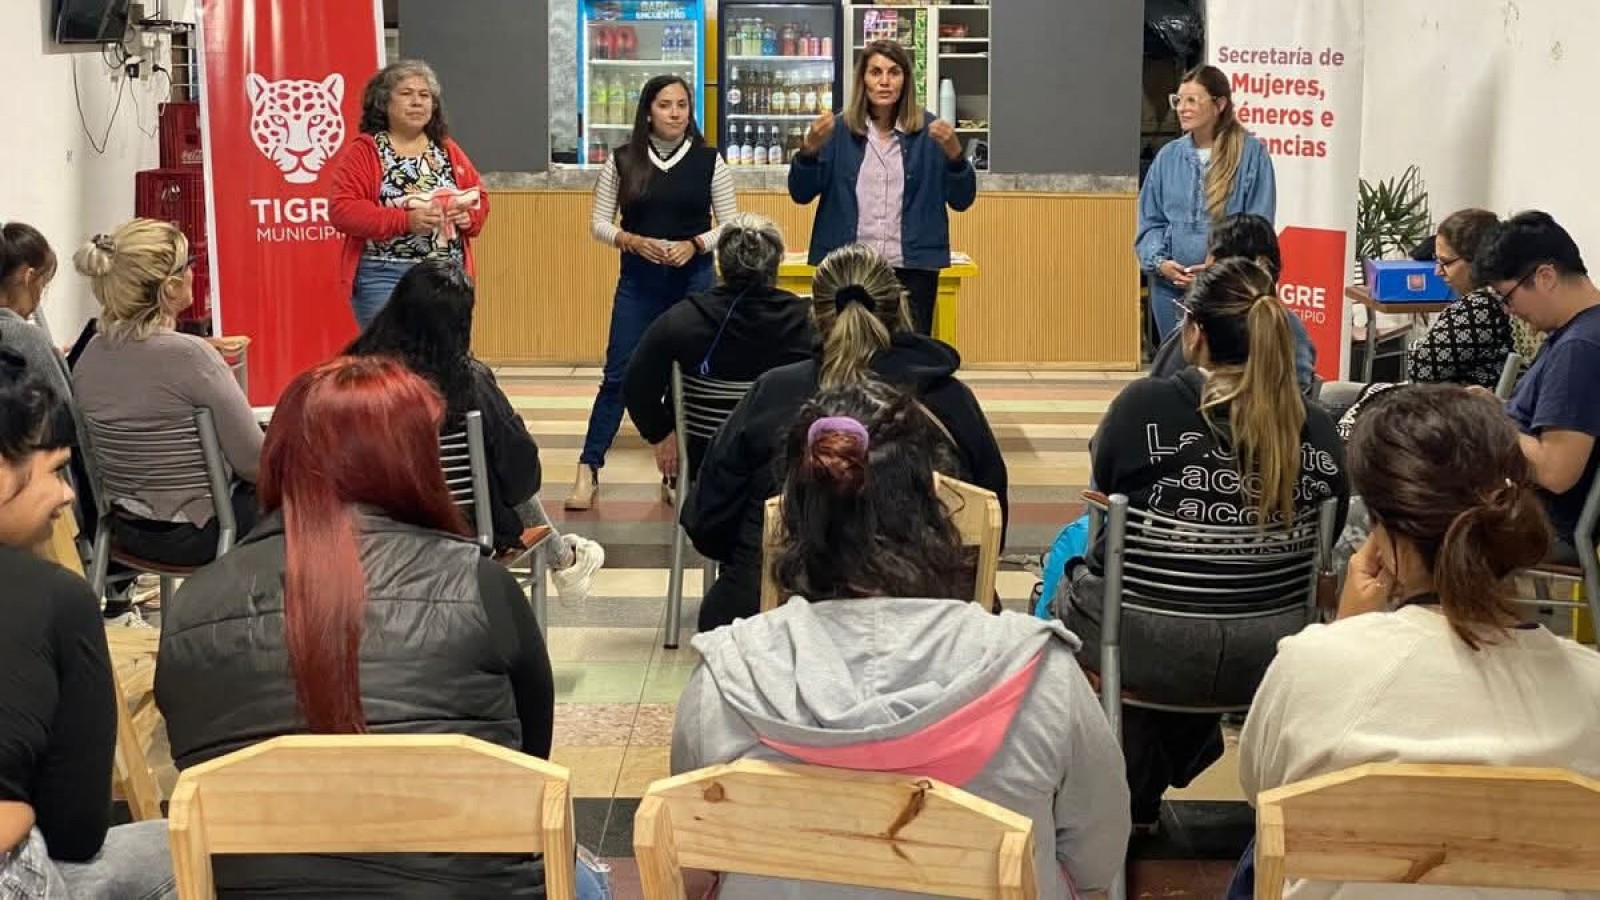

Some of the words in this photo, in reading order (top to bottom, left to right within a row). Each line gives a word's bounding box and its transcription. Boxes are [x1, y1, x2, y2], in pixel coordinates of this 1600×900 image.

[1217, 46, 1313, 65] Secretaría
[1319, 47, 1345, 66] de
[1231, 72, 1326, 100] Mujeres,
[1236, 101, 1314, 127] éneros
[1320, 109, 1334, 127] e
[1258, 134, 1326, 157] ncias
[250, 197, 330, 224] TIGR
[256, 226, 346, 242] MUNICIPI
[1276, 283, 1326, 309] GRE
